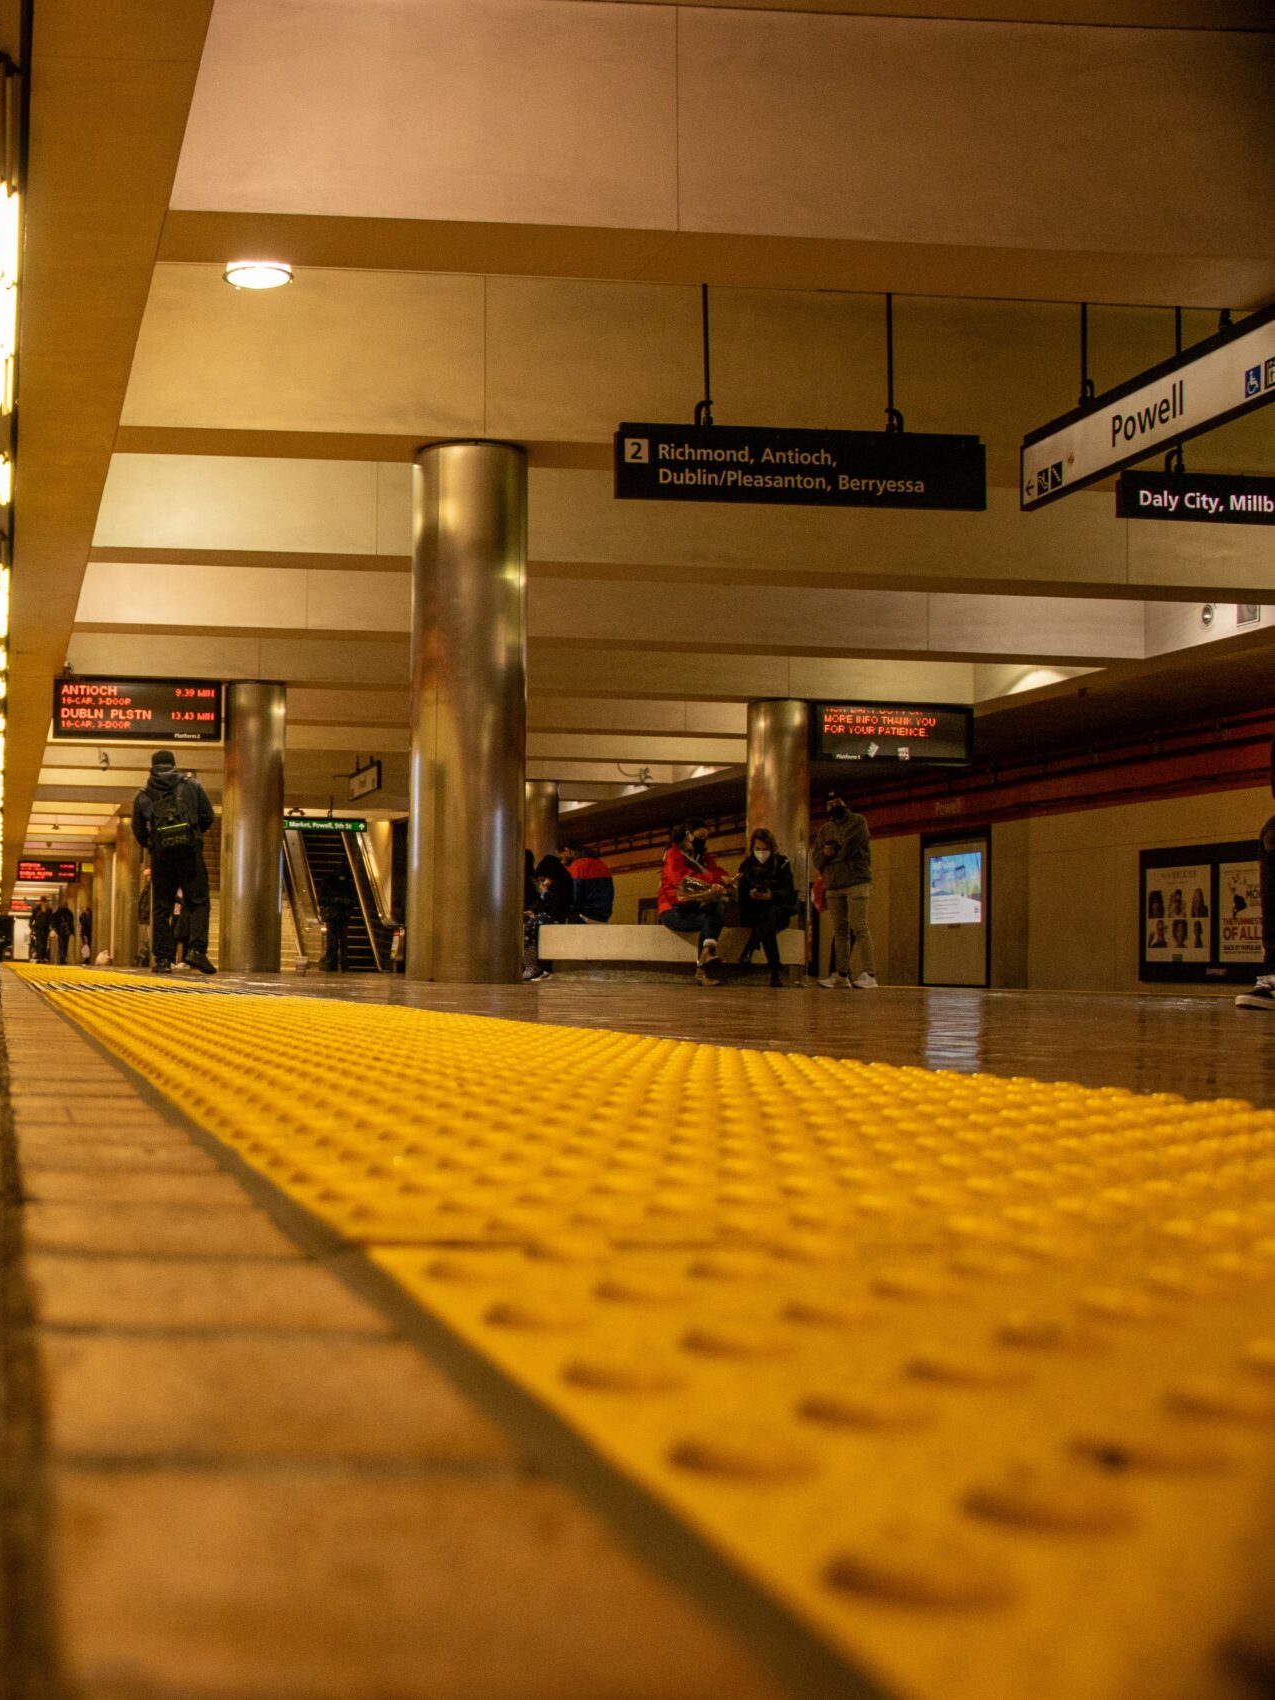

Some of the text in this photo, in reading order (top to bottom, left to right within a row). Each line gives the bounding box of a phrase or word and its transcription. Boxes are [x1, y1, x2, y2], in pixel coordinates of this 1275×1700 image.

[1112, 380, 1183, 447] Powell
[630, 442, 642, 460] 2
[658, 443, 837, 467] Richmond, Antioch,
[658, 468, 924, 496] Dublin/Pleasanton, Berryessa
[1139, 490, 1178, 511] Daly
[1184, 492, 1224, 513] City,
[61, 684, 118, 696] ANTIOCH
[197, 689, 215, 698] MIN
[98, 697, 132, 705] 3-DOOR
[61, 708, 104, 719] DUBLN
[110, 709, 152, 720] PLSTN
[197, 712, 215, 721] MIN
[824, 714, 936, 727] MORE INFO THANK YOU
[98, 720, 132, 729] 3-DOOR
[824, 725, 929, 737] FOR YOUR PATIENCE.
[1223, 925, 1261, 941] OF ALL
